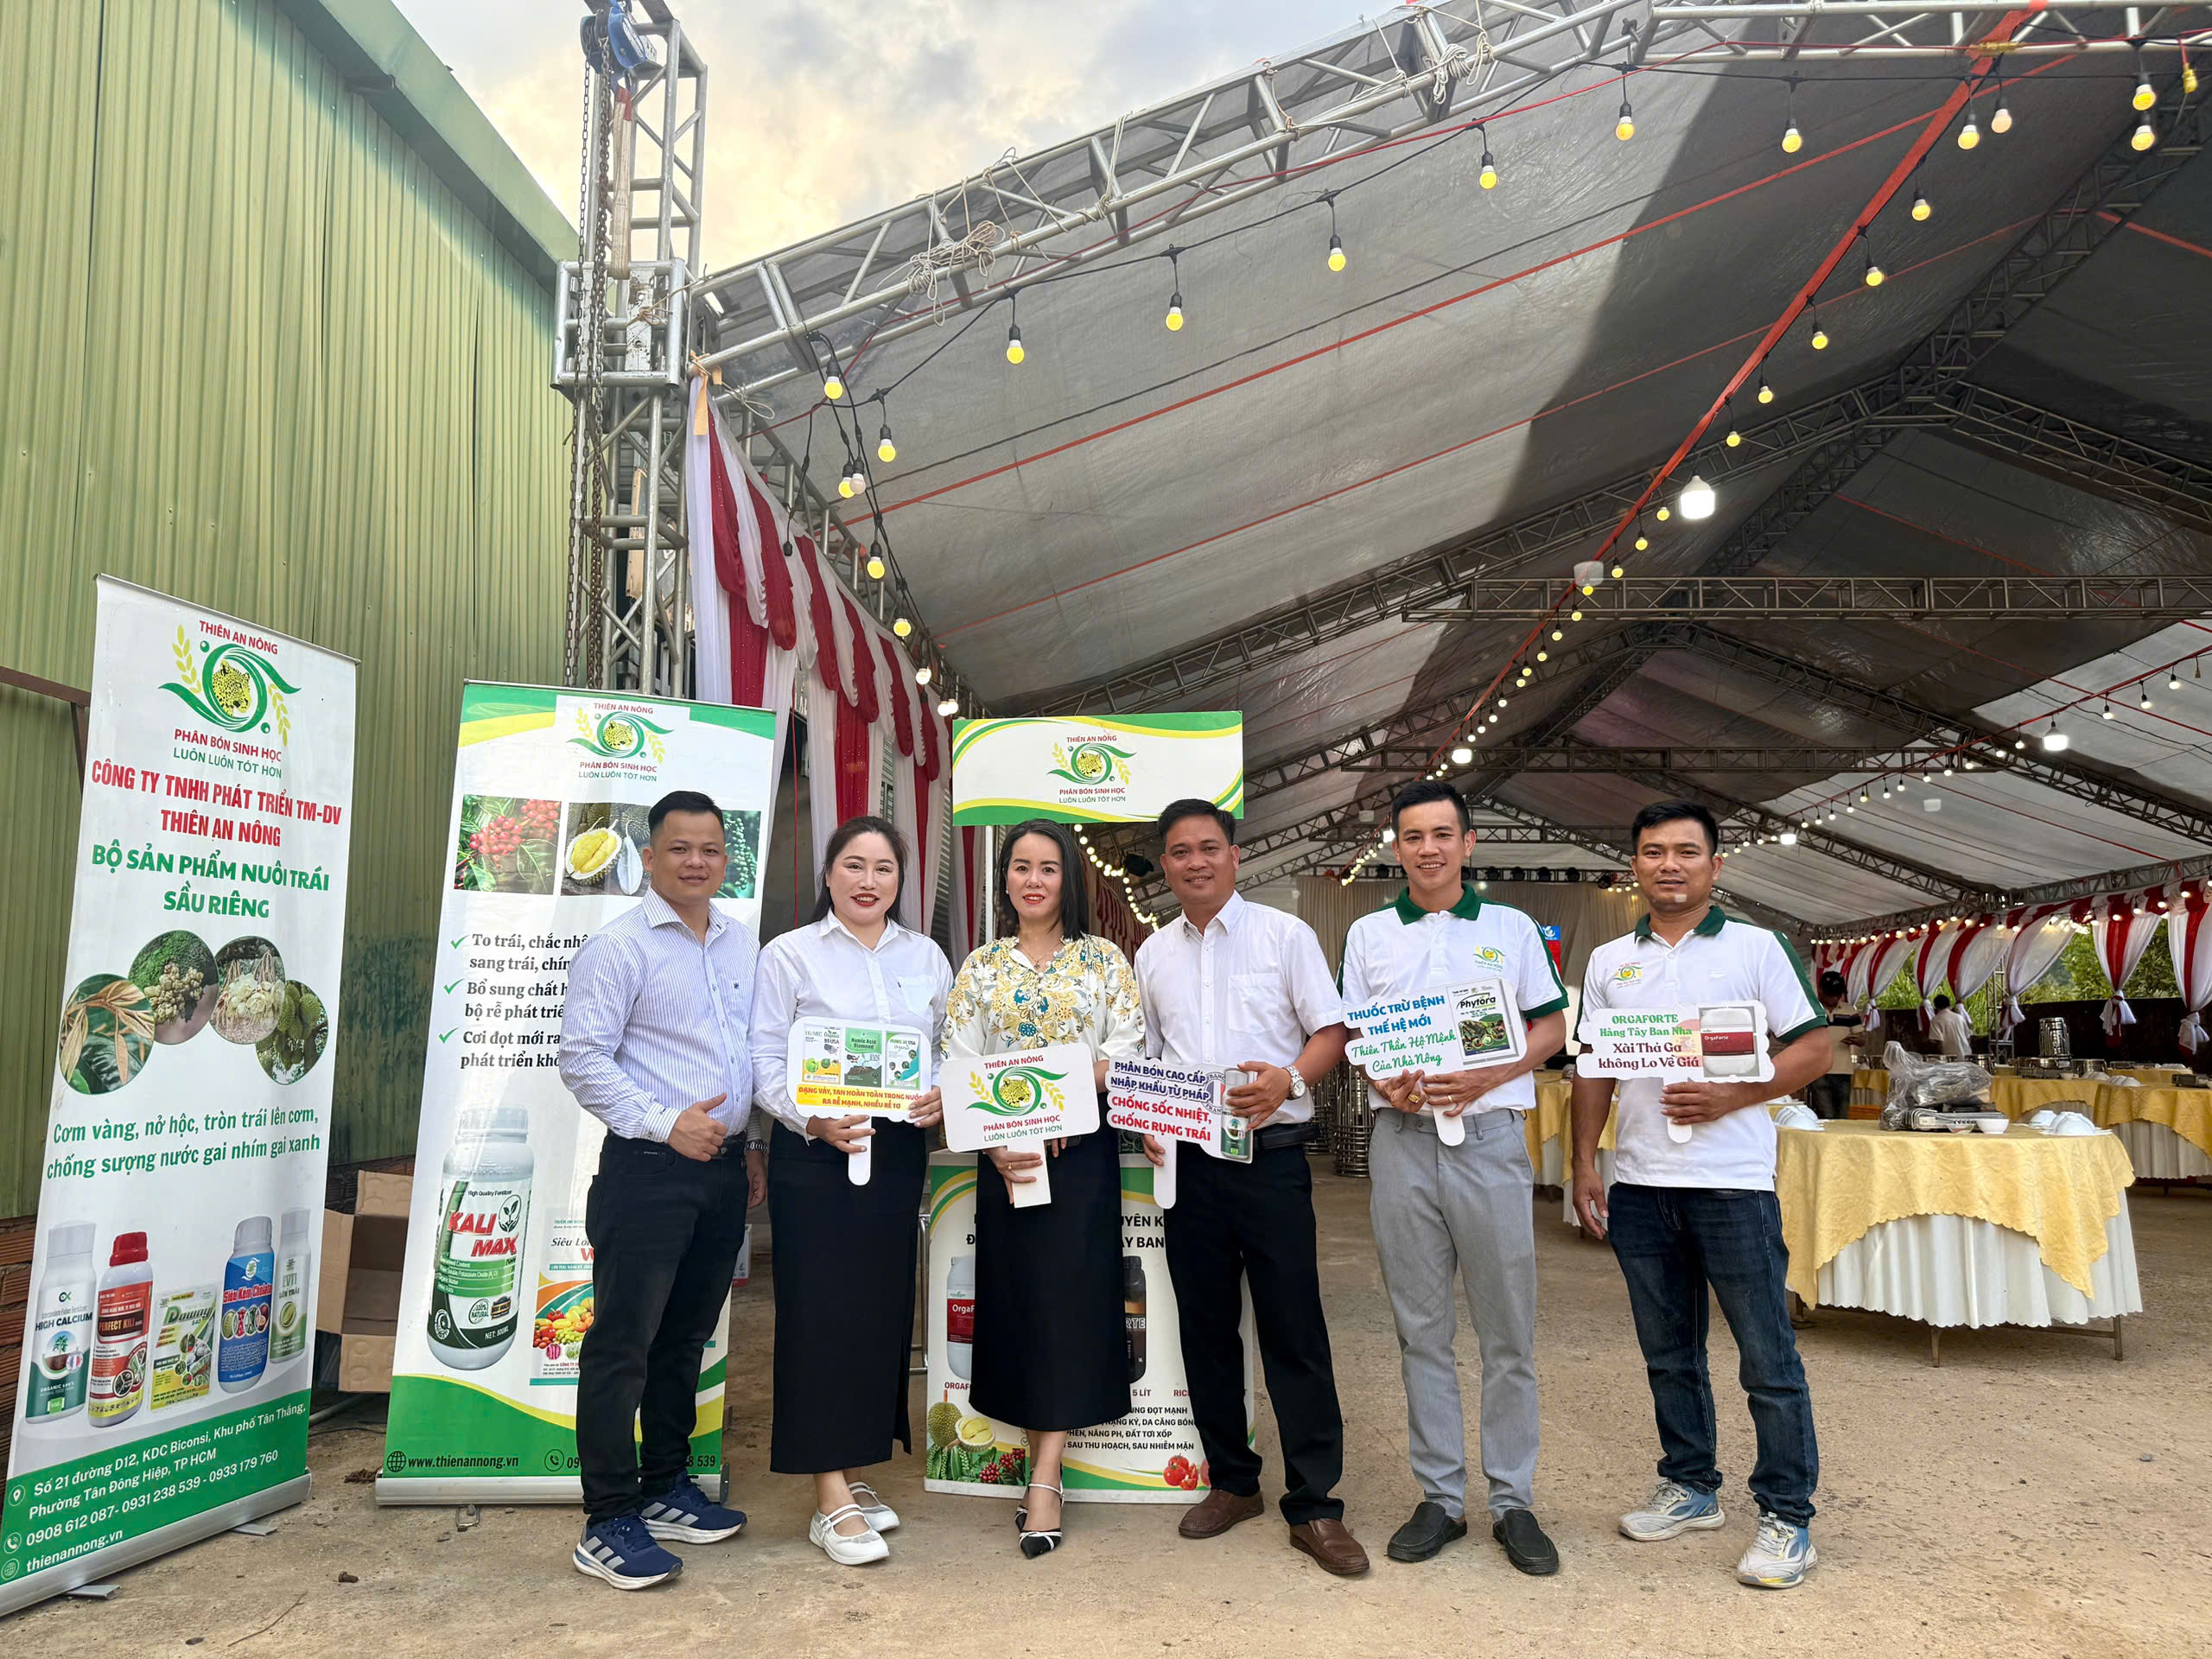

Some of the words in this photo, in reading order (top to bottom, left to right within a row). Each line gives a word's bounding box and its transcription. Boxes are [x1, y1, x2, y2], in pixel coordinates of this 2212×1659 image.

[200, 620, 230, 639] THIÊN
[232, 632, 246, 643] AN
[249, 634, 278, 655] NÔNG
[175, 729, 207, 745] PHÂN
[210, 734, 231, 749] BÓN
[232, 741, 259, 756] SINH
[261, 748, 282, 763] HỌC
[174, 747, 205, 763] LUÔN
[208, 753, 233, 769] LUÔN
[92, 759, 136, 791] CÔNG
[141, 769, 160, 793] TY
[165, 775, 208, 802] TNHH
[213, 784, 252, 809] PHÁT
[257, 789, 293, 817] TRIỂN
[296, 800, 342, 824] TM-DV
[161, 810, 209, 836] THIÊN
[213, 818, 232, 840] AN
[238, 820, 281, 847] NÔNG
[92, 839, 122, 874] BỘ
[126, 843, 174, 873] SẢN
[179, 849, 236, 880] PHẨM
[242, 860, 287, 886] NUÔI
[289, 866, 329, 891] TRÁI
[164, 880, 204, 912] SẦU
[209, 890, 270, 918] RIÊNG
[473, 934, 491, 946] To
[494, 934, 524, 950] trái,
[529, 933, 561, 948] chắc
[469, 959, 505, 972] sang
[508, 957, 538, 973] trái,
[467, 979, 487, 995] Bổ
[489, 986, 524, 999] sung
[528, 981, 557, 996] chất
[465, 1004, 482, 1021] bộ
[486, 1001, 501, 1017] rễ
[505, 1003, 537, 1020] phát
[1348, 1002, 1387, 1021] THUỐC
[1388, 1000, 1411, 1014] TRỪ
[1414, 995, 1445, 1009] BỆNH
[1460, 996, 1496, 1008] Phytora
[1368, 1022, 1389, 1035] THẾ
[1392, 1019, 1407, 1033] HỆ
[1409, 1016, 1431, 1027] MỚI
[1611, 1014, 1678, 1024] ORGAFORTE
[463, 1032, 486, 1044] Cơi
[490, 1033, 514, 1048] đọt
[517, 1031, 543, 1045] mới
[548, 1034, 560, 1044] ra
[1599, 1028, 1624, 1038] Hàng
[1627, 1027, 1647, 1037] Tây
[1649, 1027, 1670, 1036] Ban
[1672, 1027, 1692, 1035] Nha
[1352, 1044, 1379, 1058] Thiên
[1382, 1038, 1407, 1052] Thần
[1409, 1036, 1425, 1048] Hộ
[1425, 1029, 1456, 1045] Mệnh
[1613, 1043, 1635, 1053] Xài
[1637, 1042, 1662, 1052] Thả
[1664, 1043, 1681, 1052] Ga
[461, 1052, 494, 1069] phát
[498, 1051, 533, 1067] triển
[1372, 1059, 1392, 1072] Của
[1393, 1055, 1414, 1068] Nhà
[1415, 1053, 1442, 1066] Nông
[1599, 1058, 1639, 1071] không
[1642, 1058, 1657, 1068] Lo
[1660, 1054, 1675, 1067] Về
[1677, 1058, 1699, 1068] Giá
[1115, 1061, 1141, 1073] PHÂN
[1143, 1065, 1163, 1077] BÓN
[1166, 1071, 1185, 1080] CAO
[1187, 1071, 1205, 1084] CẤP
[884, 1091, 904, 1100] TRONG
[1111, 1077, 1136, 1090] NHẬP
[1139, 1080, 1166, 1093] KHẨU
[1168, 1085, 1182, 1096] TỪ
[1183, 1088, 1209, 1101] PHÁP
[1112, 1095, 1149, 1111] CHỐNG
[1152, 1100, 1173, 1114] SỐC
[1175, 1107, 1211, 1124] NHIỆT,
[54, 1123, 86, 1143] Cơm
[92, 1118, 139, 1141] vàng,
[145, 1114, 165, 1135] nở
[169, 1113, 198, 1137] hộc,
[205, 1110, 236, 1131] tròn
[242, 1109, 267, 1128] trái
[270, 1107, 286, 1125] lên
[289, 1108, 318, 1124] cơm,
[1024, 1117, 1042, 1126] SINH
[1111, 1113, 1149, 1128] CHỐNG
[1152, 1122, 1182, 1135] RỤNG
[1185, 1127, 1211, 1141] TRÁI
[48, 1154, 95, 1179] chống
[101, 1153, 156, 1176] sượng
[161, 1146, 199, 1166] nước
[203, 1142, 226, 1165] gai
[232, 1141, 266, 1160] nhím
[270, 1136, 286, 1158] gai
[289, 1135, 320, 1153] xanh
[448, 1212, 497, 1235] KALI
[471, 1236, 518, 1256] MAX
[551, 1237, 572, 1246] Siêu
[1137, 1237, 1164, 1248] BAN
[35, 1319, 54, 1331] HIGH
[56, 1313, 92, 1326] CALCIUM
[99, 1320, 121, 1332] PERFECT
[1147, 1407, 1163, 1415] ĐỌT
[1165, 1407, 1187, 1416] MẠNH
[35, 1479, 52, 1497] Số
[55, 1475, 69, 1489] 21
[72, 1465, 111, 1484] đường
[116, 1453, 139, 1471] D12,
[143, 1445, 168, 1461] KDC
[170, 1432, 211, 1453] Biconsi,
[214, 1425, 233, 1440] Khu
[236, 1417, 255, 1434] phố
[257, 1414, 274, 1425] Tân
[276, 1403, 306, 1422] Thắng,
[408, 1455, 518, 1469] www.thienannong.vn
[697, 1455, 715, 1468] 539
[29, 1498, 80, 1519] Phường
[84, 1486, 106, 1501] Tân
[110, 1474, 139, 1493] Đông
[143, 1464, 171, 1484] Hiệp,
[174, 1458, 188, 1470] TP
[190, 1449, 216, 1465] HCM
[26, 1528, 61, 1546] 0908
[65, 1519, 87, 1534] 612
[122, 1495, 150, 1514] 0931
[153, 1485, 176, 1503] 238
[178, 1478, 200, 1492] 539
[209, 1465, 237, 1483] 0933
[239, 1459, 257, 1471] 179
[260, 1450, 278, 1465] 760
[27, 1529, 124, 1572] thienannong.vn
